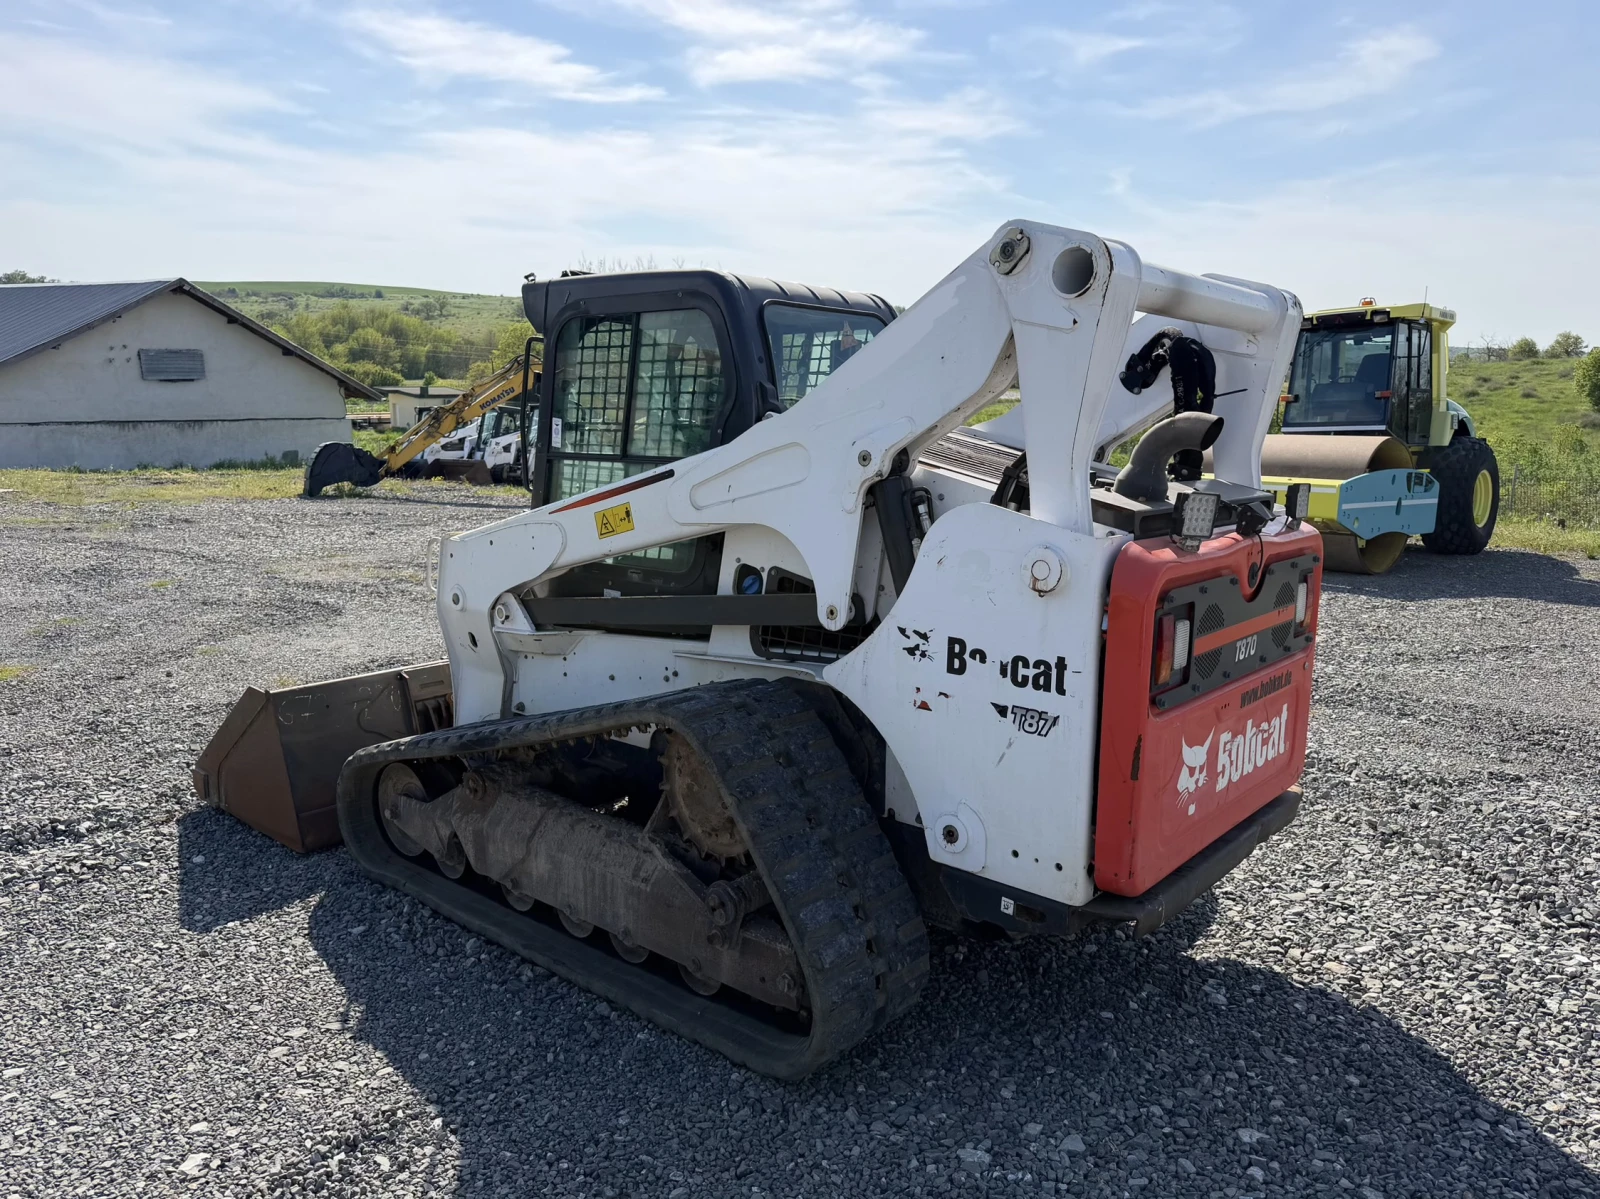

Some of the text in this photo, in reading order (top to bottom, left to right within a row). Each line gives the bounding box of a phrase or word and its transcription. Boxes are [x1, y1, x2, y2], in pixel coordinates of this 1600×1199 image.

[479, 386, 516, 411] KOMATSU
[1235, 634, 1258, 663] T870
[1215, 702, 1288, 793] Bobcat
